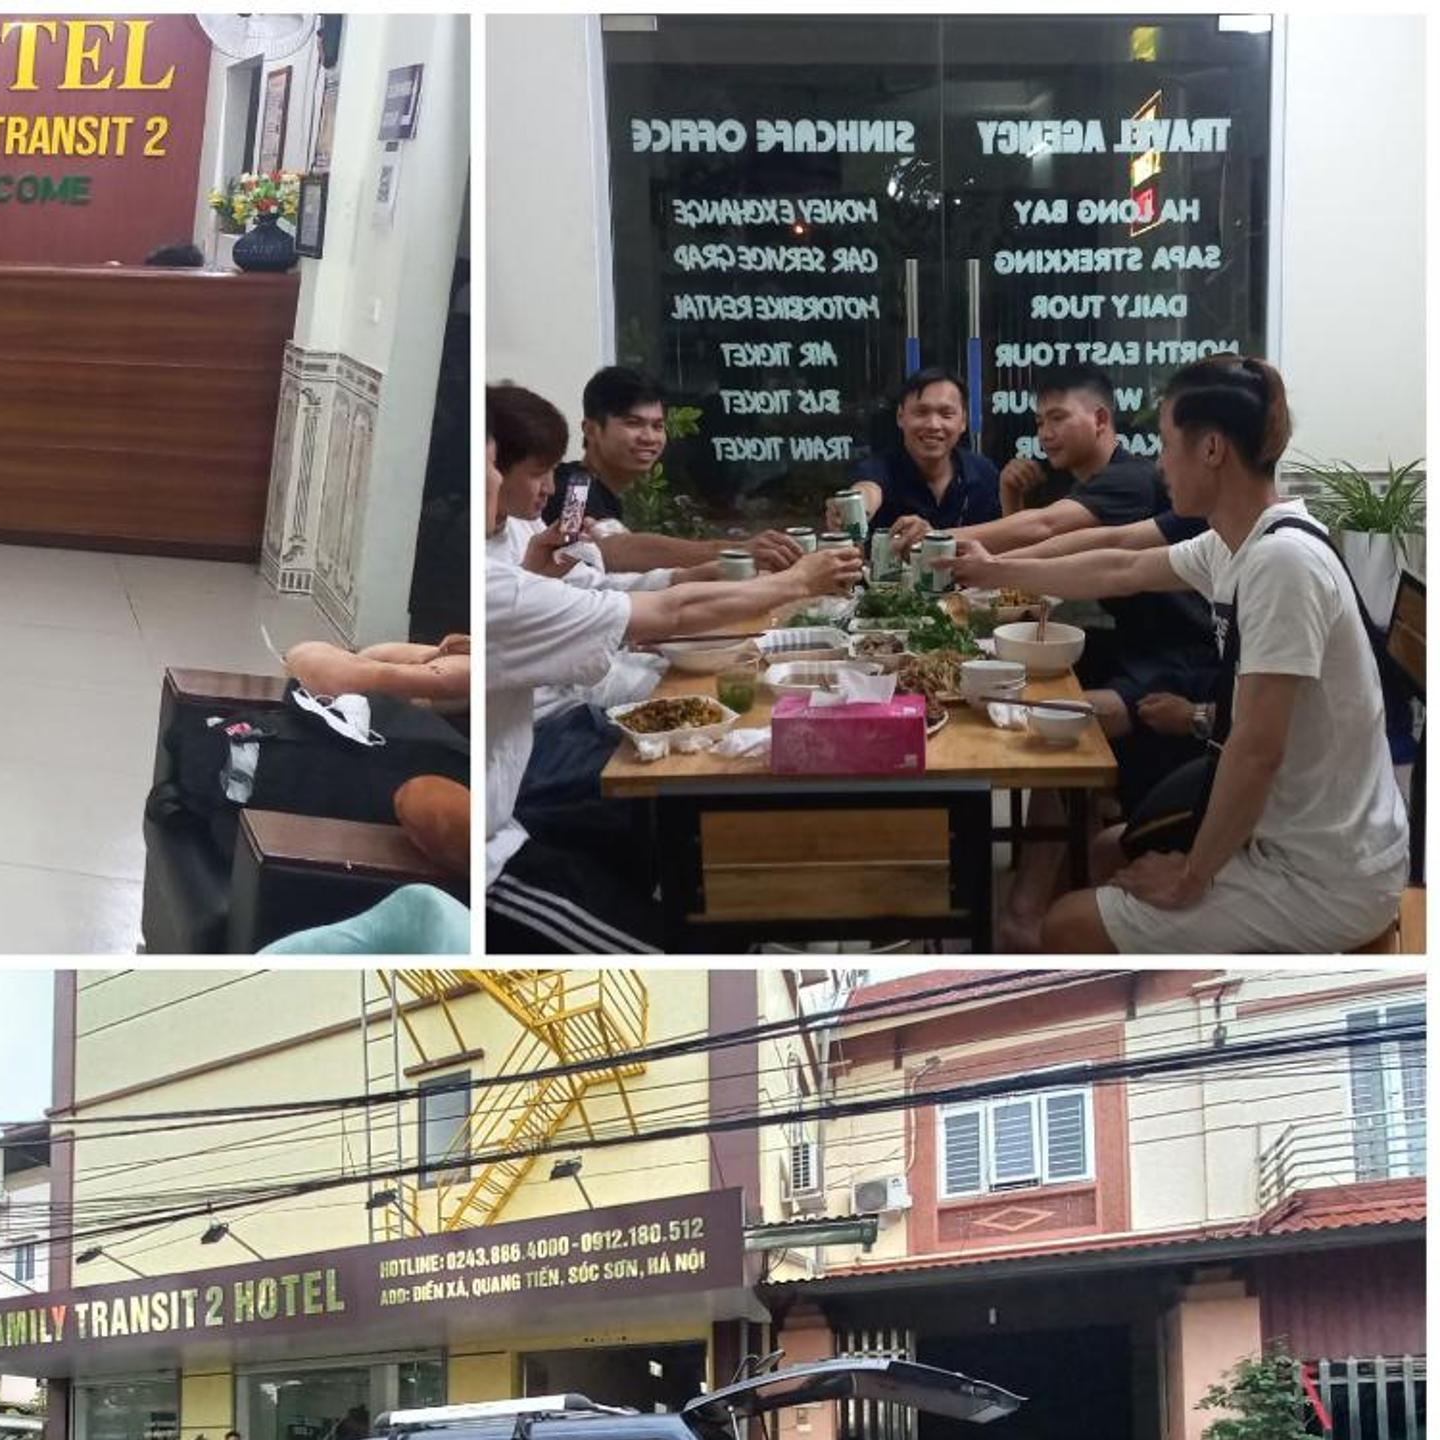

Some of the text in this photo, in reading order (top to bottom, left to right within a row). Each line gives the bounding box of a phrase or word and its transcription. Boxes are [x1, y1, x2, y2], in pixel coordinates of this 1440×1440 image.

[143, 117, 169, 156] 2
[380, 1254, 445, 1279] HOTLINE:
[472, 1273, 521, 1297] QUANG
[567, 1260, 600, 1285] SÓC
[74, 1287, 199, 1340] TRANSIT
[205, 1284, 224, 1326] 2
[233, 1268, 345, 1324] HOTEL
